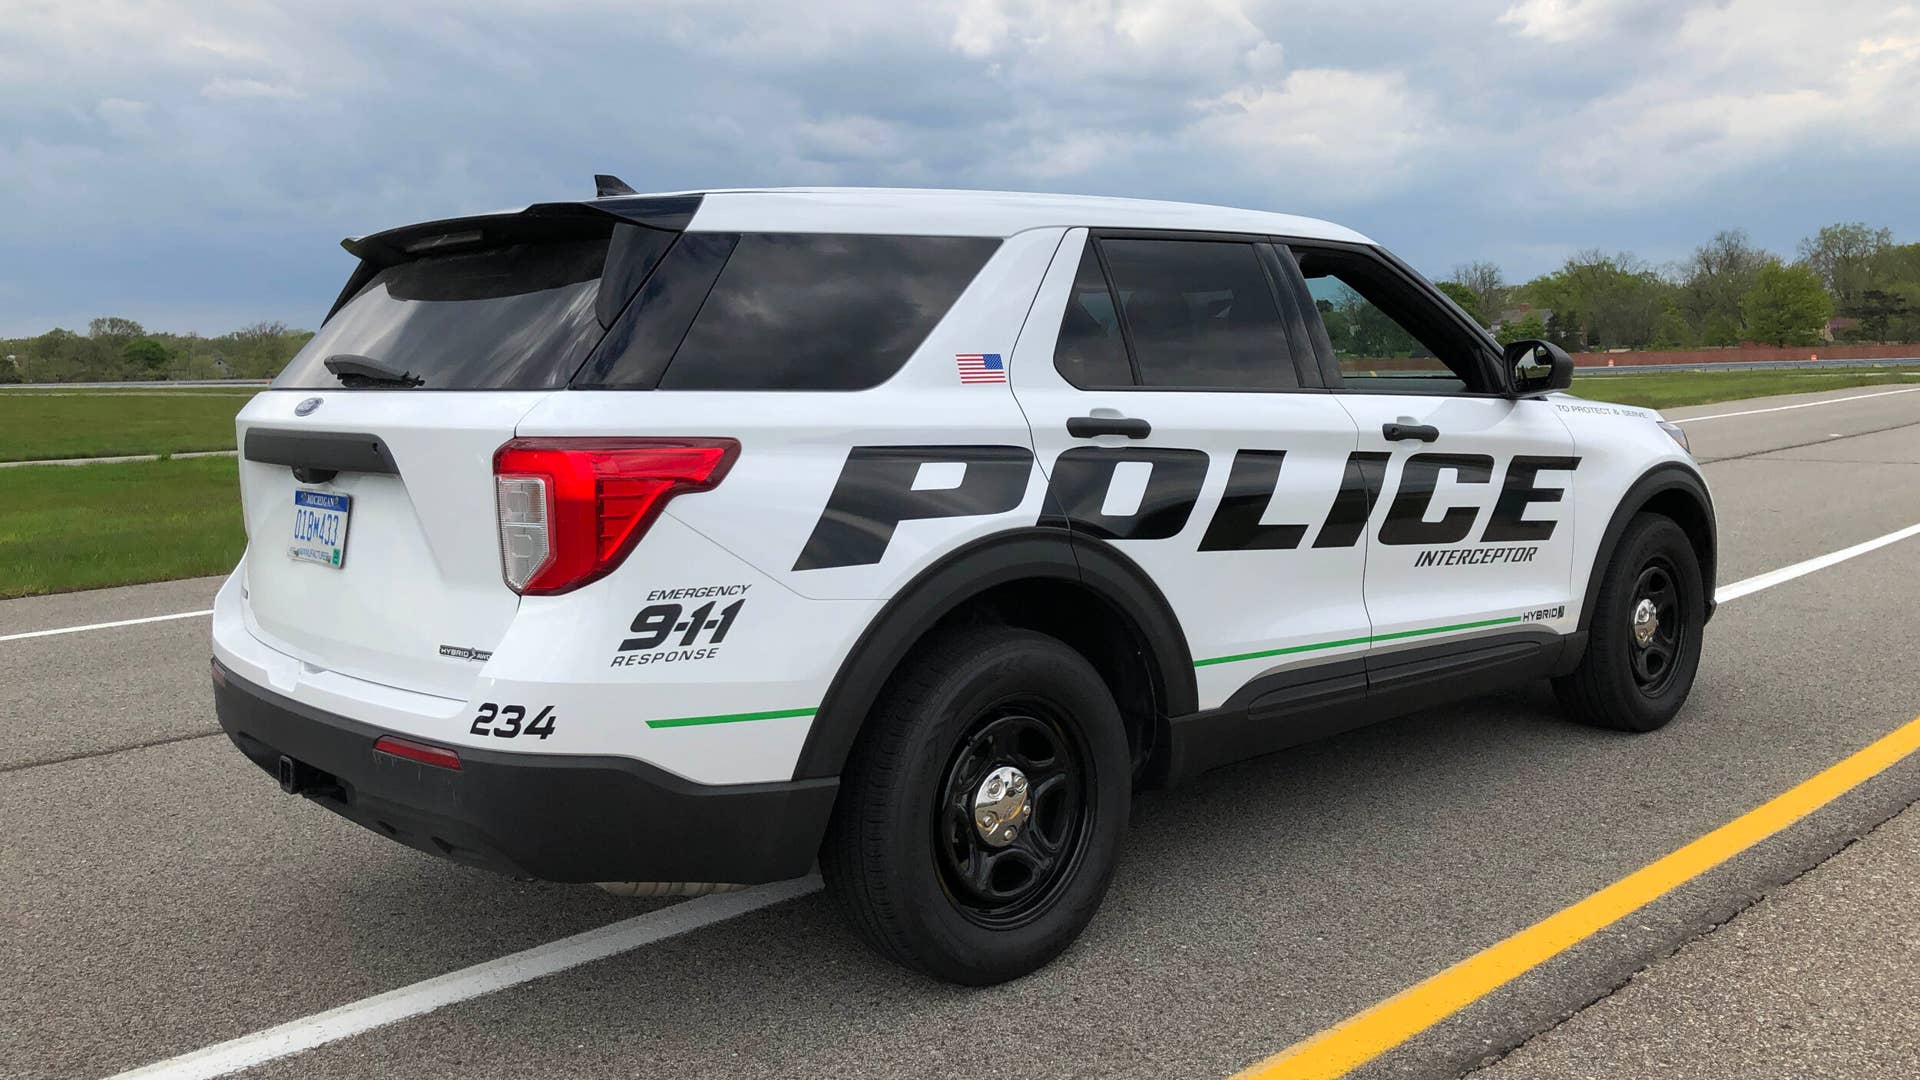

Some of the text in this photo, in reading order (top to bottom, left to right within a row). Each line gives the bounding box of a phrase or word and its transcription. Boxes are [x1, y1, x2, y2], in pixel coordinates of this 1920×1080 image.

[1556, 405, 1569, 413] TO
[1571, 405, 1611, 415] PROTECT
[307, 494, 334, 506] MICHIGAN
[792, 445, 1582, 572] POLICE
[1414, 546, 1538, 567] INTERCEPTOR
[646, 584, 752, 601] EMERGENCY
[1523, 607, 1558, 622] HYBRID
[440, 647, 491, 661] HYBRID AWD
[610, 648, 719, 667] RESPONSE
[470, 702, 556, 740] 234
